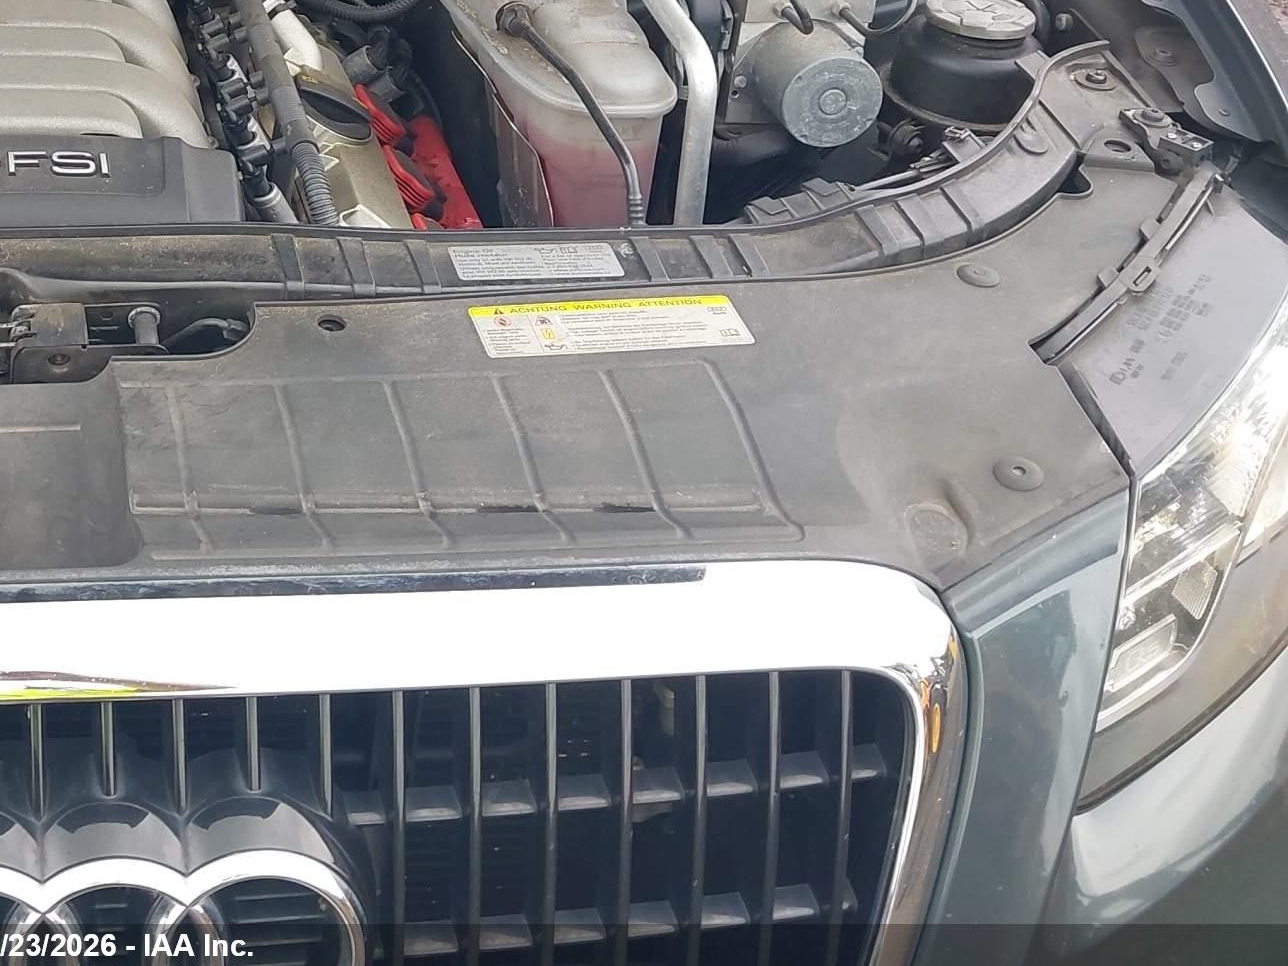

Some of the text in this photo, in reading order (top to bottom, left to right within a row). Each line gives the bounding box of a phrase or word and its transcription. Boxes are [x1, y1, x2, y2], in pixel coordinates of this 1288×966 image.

[510, 298, 703, 315] ACHTUNG WARNING ATTENTION
